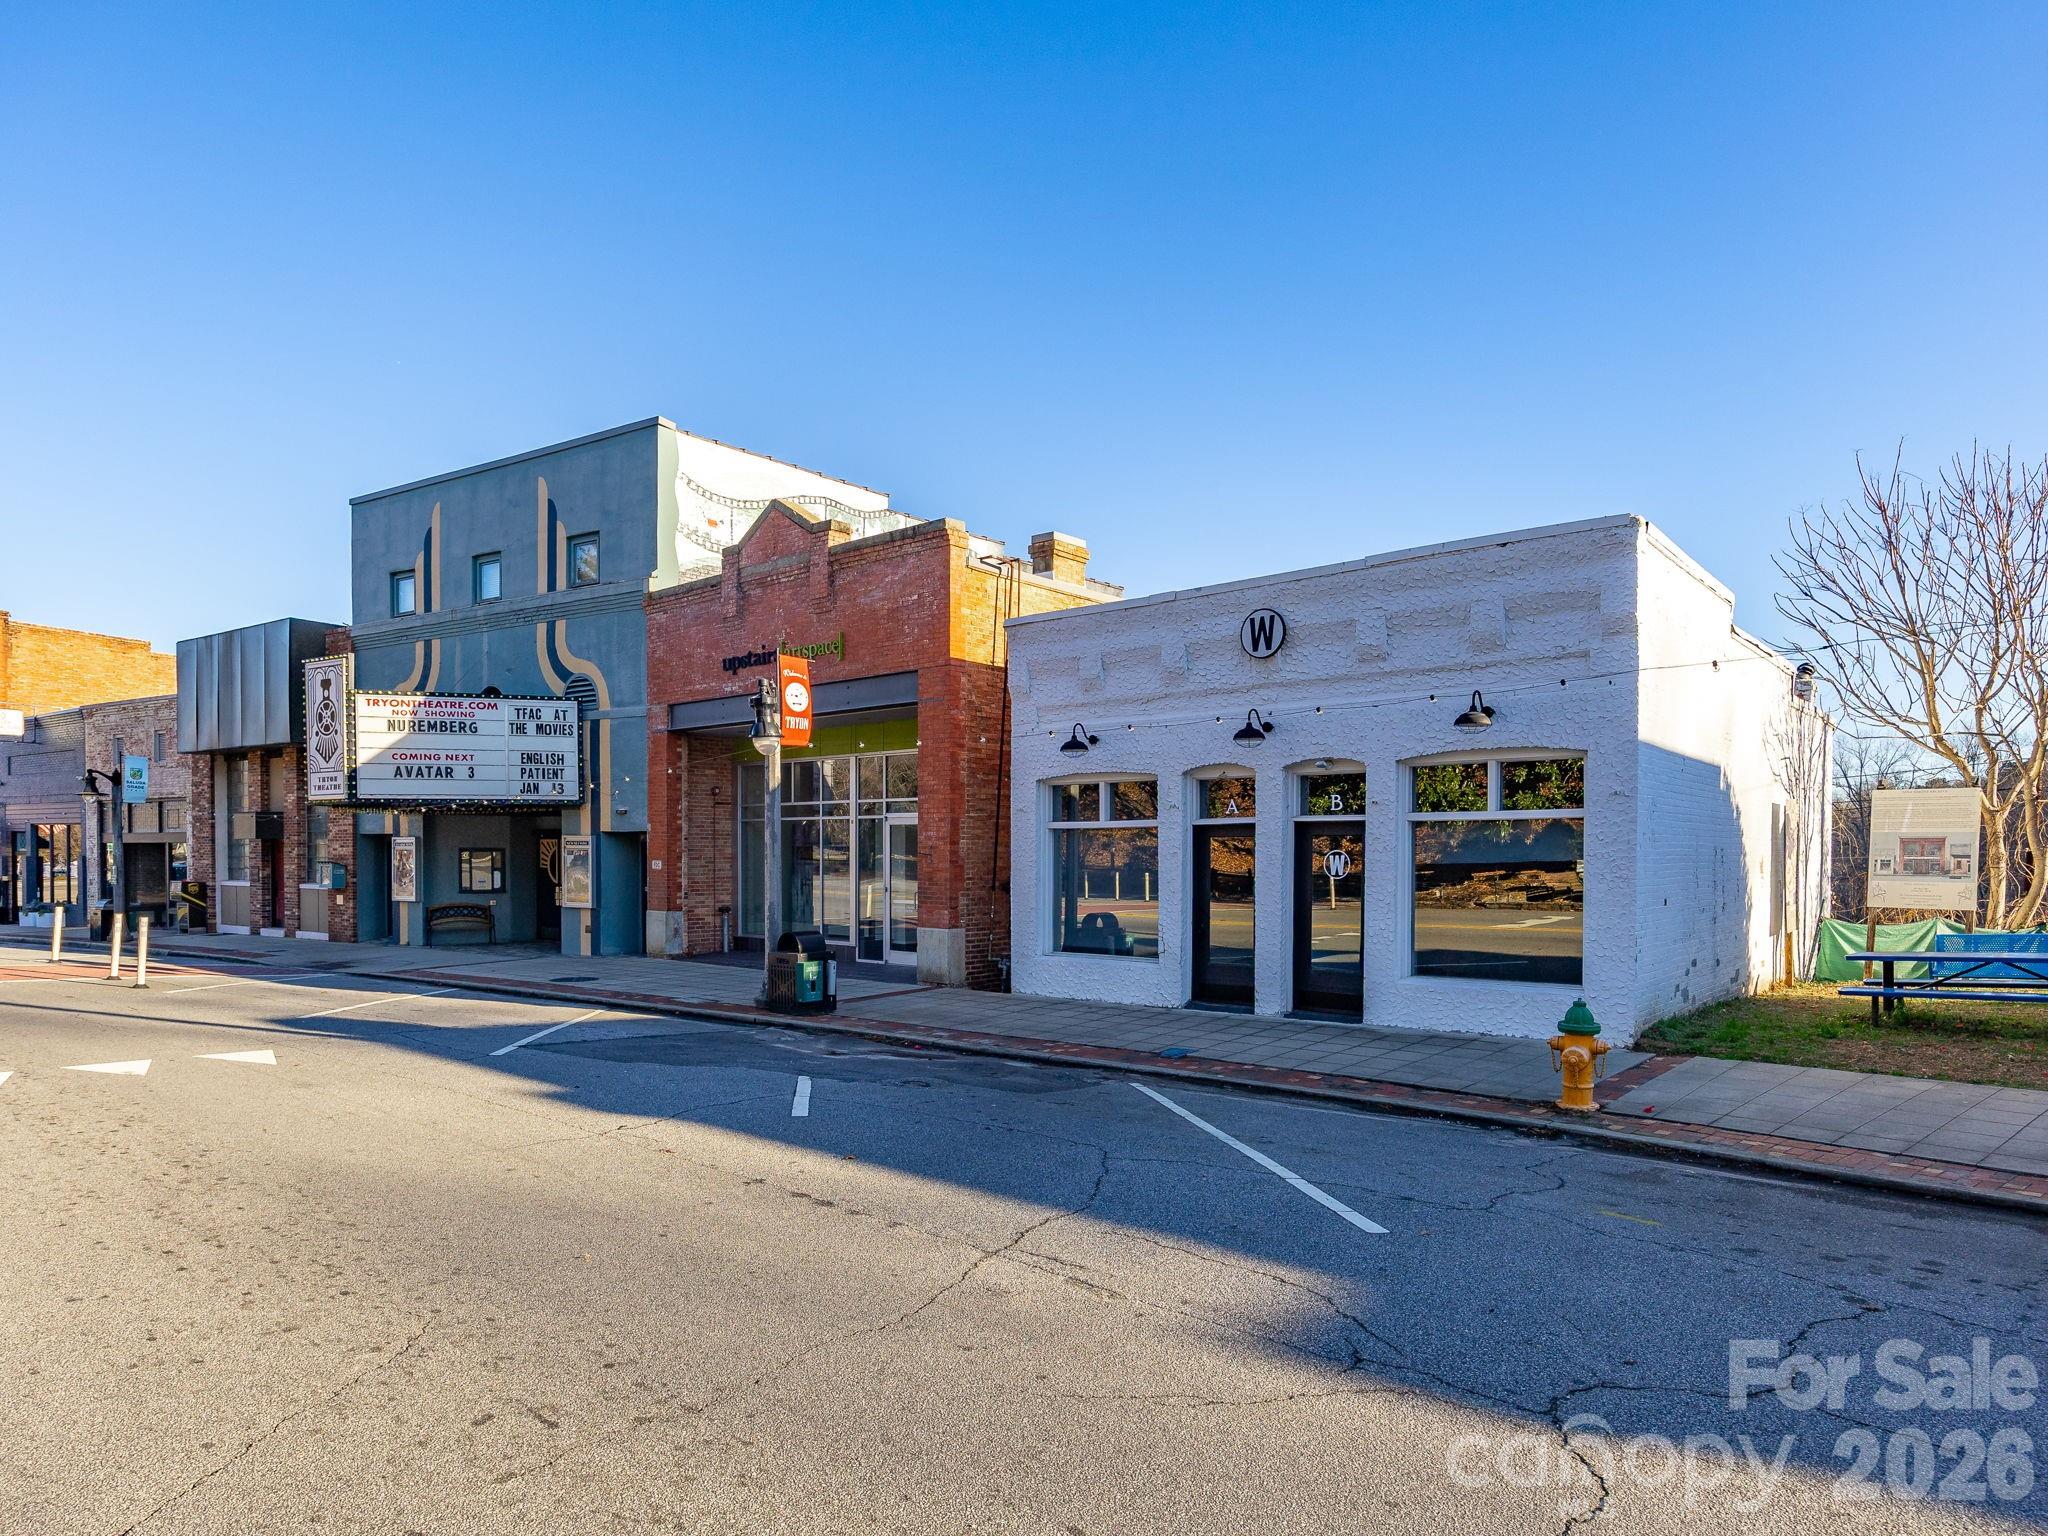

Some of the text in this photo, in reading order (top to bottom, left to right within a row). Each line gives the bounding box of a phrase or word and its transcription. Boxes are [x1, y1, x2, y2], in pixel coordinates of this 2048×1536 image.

[1249, 614, 1275, 652] W
[365, 698, 498, 711] TRYONTHEATRE.COM
[391, 709, 476, 718] NOW SHOWING
[514, 708, 568, 721] TFAC AT
[387, 719, 478, 734] NUREMBERG
[509, 722, 574, 736] THE MOVIES
[785, 716, 809, 730] TRYON
[391, 753, 475, 762] COMING NEXT
[520, 752, 565, 765] ENGLISH
[394, 766, 475, 779] AVATAR 3
[520, 767, 565, 780] PATIENT
[520, 782, 539, 795] JAN
[1225, 799, 1239, 814] A
[1330, 794, 1343, 810] B
[1329, 855, 1345, 876] W
